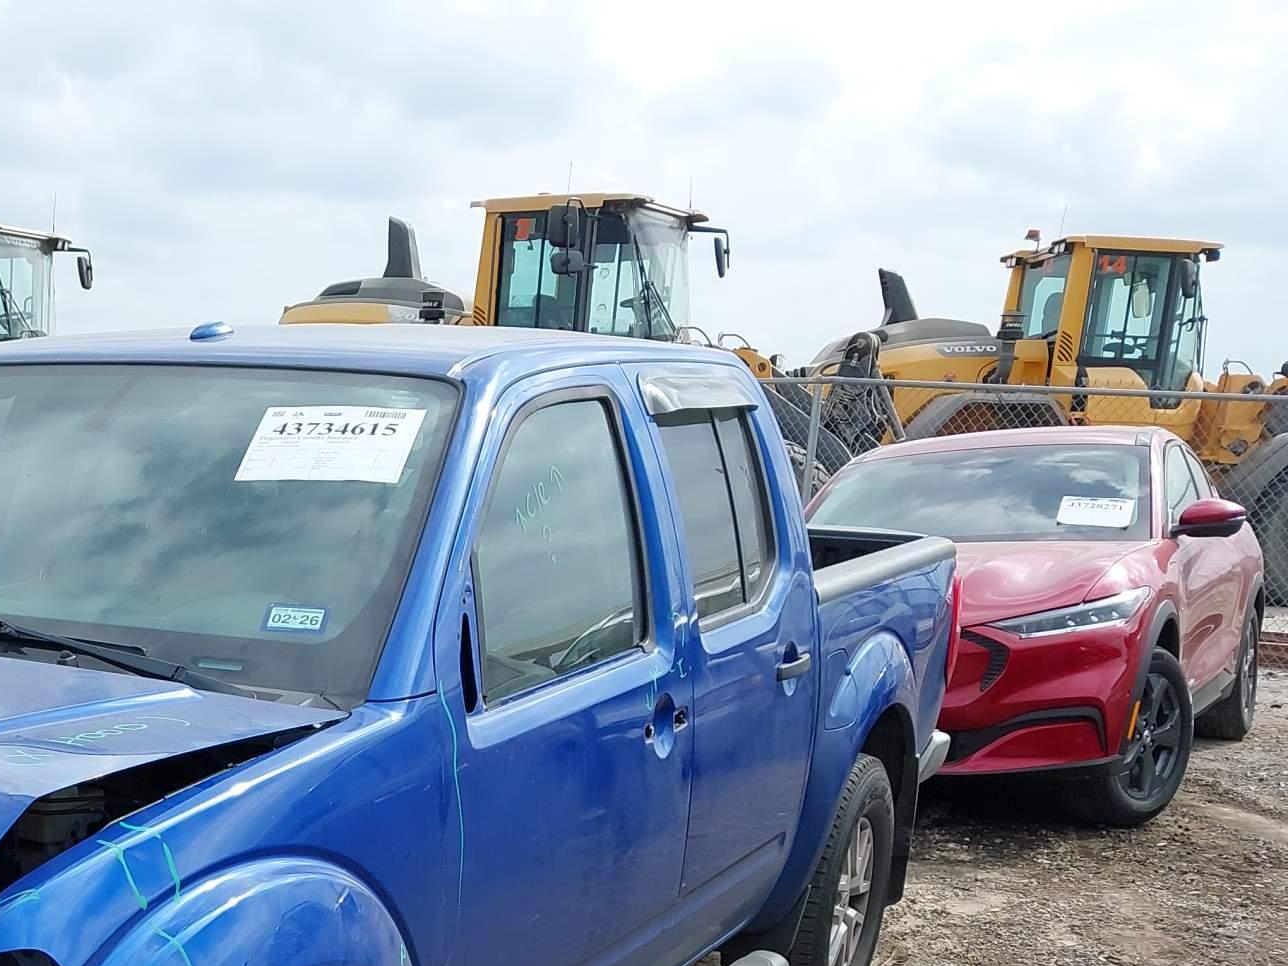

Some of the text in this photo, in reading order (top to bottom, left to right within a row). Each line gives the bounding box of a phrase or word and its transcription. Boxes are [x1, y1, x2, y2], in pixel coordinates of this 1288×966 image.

[1099, 255, 1127, 274] 14
[942, 344, 998, 354] VOLVO
[272, 422, 400, 437] 43734615
